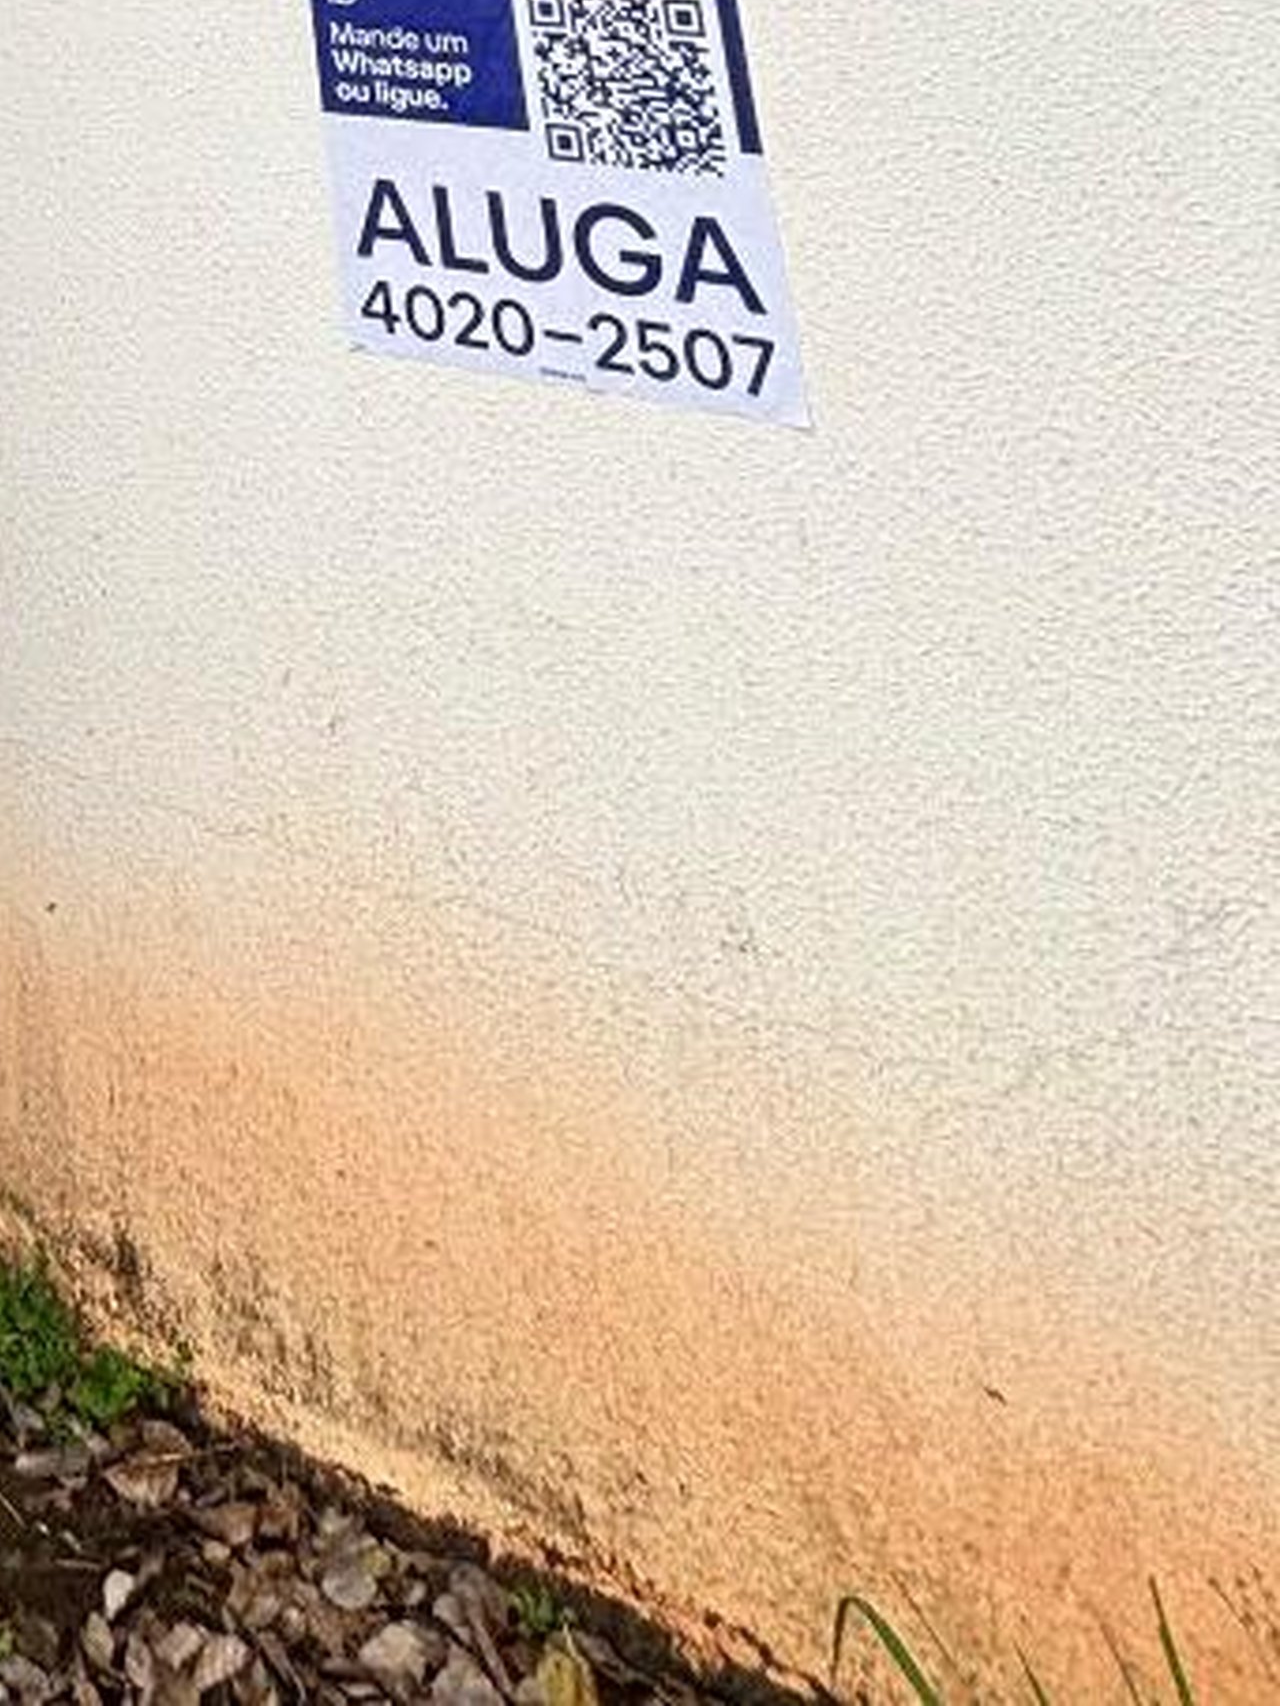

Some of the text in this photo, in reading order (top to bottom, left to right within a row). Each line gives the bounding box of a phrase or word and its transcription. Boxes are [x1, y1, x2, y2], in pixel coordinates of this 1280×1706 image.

[329, 21, 469, 54] Mande um
[330, 48, 472, 88] Whatsapp
[336, 80, 450, 113] ou ligue.
[357, 178, 768, 316] ALUGA
[360, 280, 776, 397] 4020-2507
